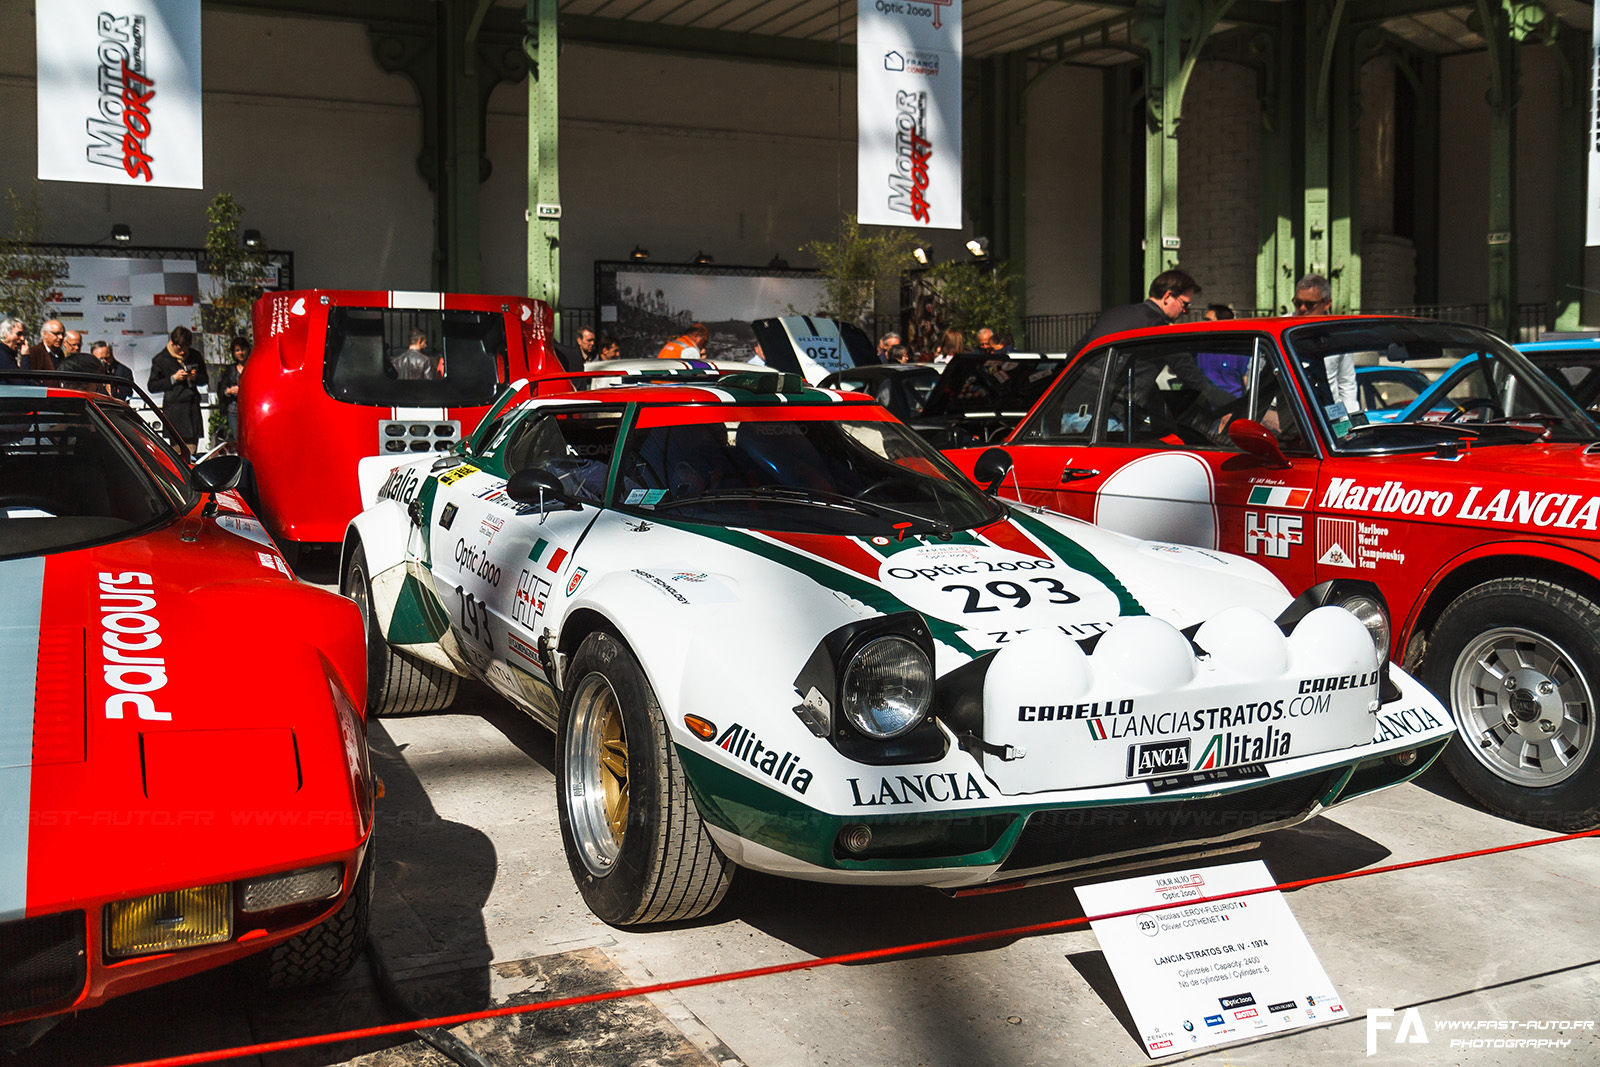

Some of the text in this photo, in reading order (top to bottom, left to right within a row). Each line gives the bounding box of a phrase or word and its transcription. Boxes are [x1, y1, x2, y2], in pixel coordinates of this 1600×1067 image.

[875, 0, 932, 18] Optic 2000
[121, 57, 155, 183] SPORT
[910, 126, 933, 225] SPORT
[806, 347, 840, 360] 250
[754, 424, 809, 436] RECARO
[1318, 477, 1600, 530] Marlboro LANCIA
[1244, 511, 1304, 560] HF
[1358, 522, 1389, 536] Marlboro
[1358, 534, 1379, 546] World
[455, 537, 501, 588] Optic 2000
[1358, 545, 1405, 565] Championship
[1358, 557, 1377, 570] Team
[887, 559, 1056, 582] Optic 2000
[512, 568, 552, 631] HF
[941, 577, 1081, 613] 293
[455, 584, 495, 652] 293
[98, 571, 173, 722] parcours
[1298, 669, 1379, 695] CARELLO
[1018, 698, 1134, 722] CARELLO
[1111, 694, 1332, 739] LANCIASTRATOS.COM
[714, 722, 814, 795] Alitalia
[1132, 742, 1190, 777] LANCIA
[1193, 725, 1292, 771] Alitalia
[846, 771, 990, 807] LANCIA
[1161, 889, 1197, 901] Optic 2000
[1156, 902, 1239, 922] Nicolas LEROY-FLEURIOT
[1161, 915, 1221, 932] Olivier COTHENET
[1139, 920, 1156, 931] 293
[1153, 954, 1186, 966] LANCIA
[1185, 946, 1223, 960] STRATOS
[1222, 944, 1238, 954] GR.
[1237, 942, 1246, 951] IV
[1251, 939, 1269, 949] 1974
[1214, 960, 1244, 973] Capacity:
[1244, 956, 1261, 966] 2400
[1178, 980, 1190, 988] Nb
[1190, 978, 1200, 987] de
[1199, 973, 1229, 986] cylindres
[1232, 967, 1264, 980] Cylinders:
[1263, 965, 1270, 973] 6
[1236, 1009, 1257, 1019] MOTUL
[1147, 1031, 1174, 1042] ZENITH
